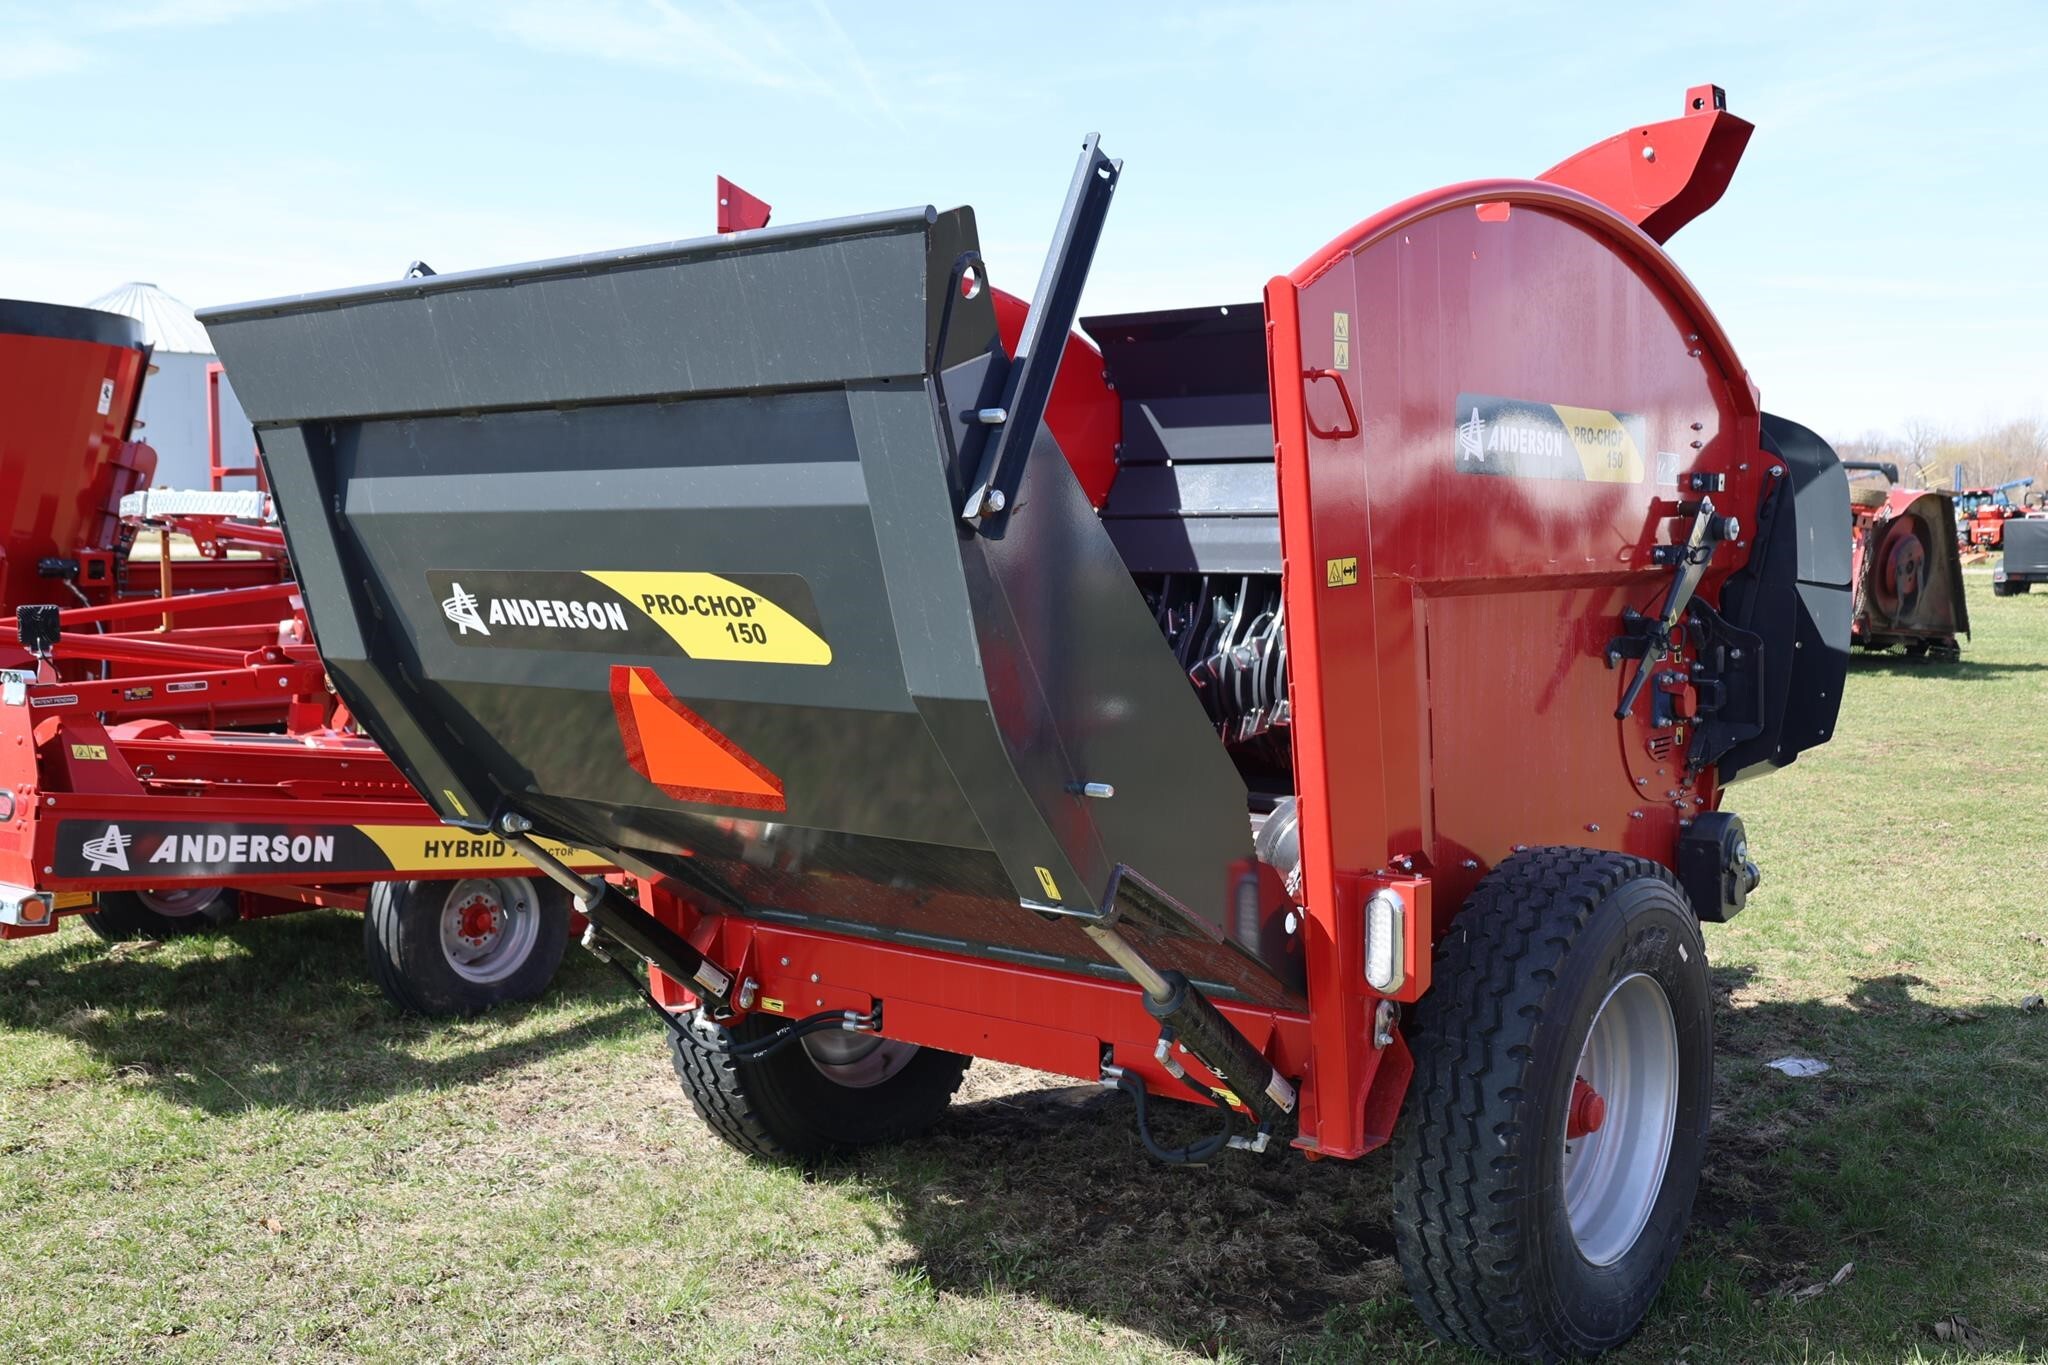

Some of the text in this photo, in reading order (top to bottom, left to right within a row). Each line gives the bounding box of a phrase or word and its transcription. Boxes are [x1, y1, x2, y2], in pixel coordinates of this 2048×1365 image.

[1487, 425, 1563, 457] ANDERSON
[1607, 452, 1623, 469] 150
[489, 598, 629, 631] ANDERSON
[641, 594, 757, 617] PRO-CHOP
[725, 622, 767, 644] 150
[149, 835, 334, 863] ANDERSON
[424, 840, 505, 857] HYBRID
